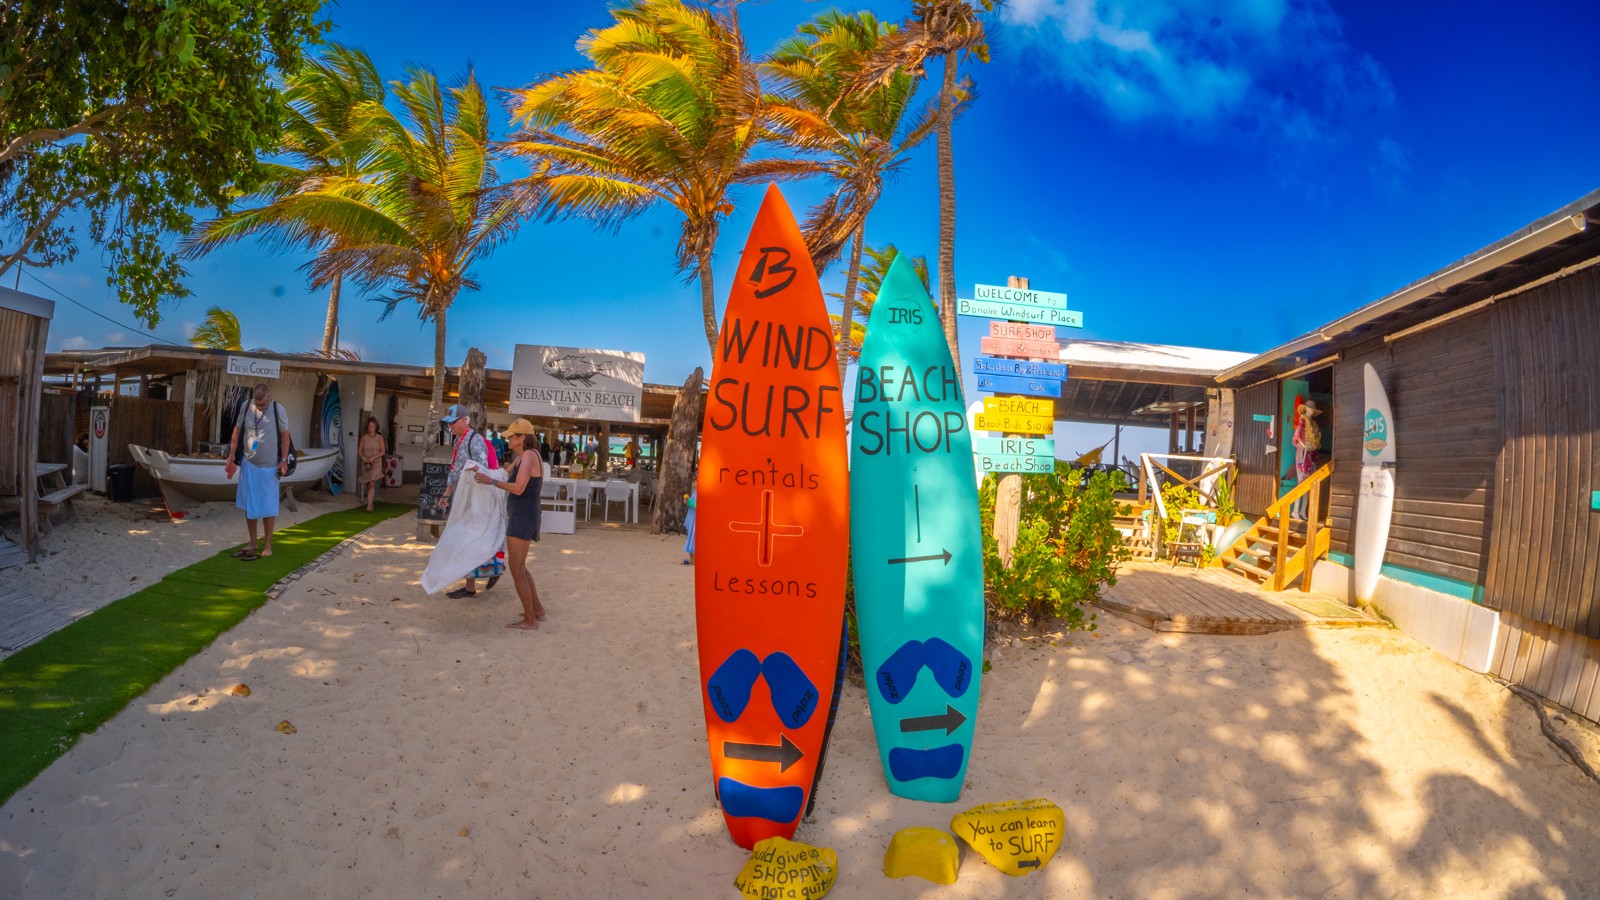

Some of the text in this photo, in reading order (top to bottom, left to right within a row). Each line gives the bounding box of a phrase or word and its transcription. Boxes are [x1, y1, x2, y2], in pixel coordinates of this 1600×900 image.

[749, 246, 797, 298] B
[977, 287, 1039, 304] WELCOME
[887, 306, 923, 325] IRIS
[960, 300, 1076, 324] Bonaire Windsurf Place
[992, 324, 1052, 339] SURF SHOP
[723, 317, 832, 371] WIND
[1016, 343, 1026, 354] &
[858, 364, 959, 403] BEACH
[516, 387, 636, 407] SEBASTIAN'S BEACH
[999, 400, 1039, 413] BEACH
[556, 405, 592, 413] SOROBON
[710, 377, 840, 439] SURF
[978, 416, 1003, 428] Beach
[1365, 416, 1385, 434] IRIS
[860, 410, 965, 456] SHOP
[1000, 439, 1035, 455] IRIS
[982, 457, 1051, 473] Beach Shop
[719, 463, 819, 489] rentals
[714, 572, 817, 598] Lessons
[968, 816, 1056, 841] You can learn
[989, 832, 1055, 856] to SURF
[776, 851, 807, 870] give
[787, 889, 797, 899] a
